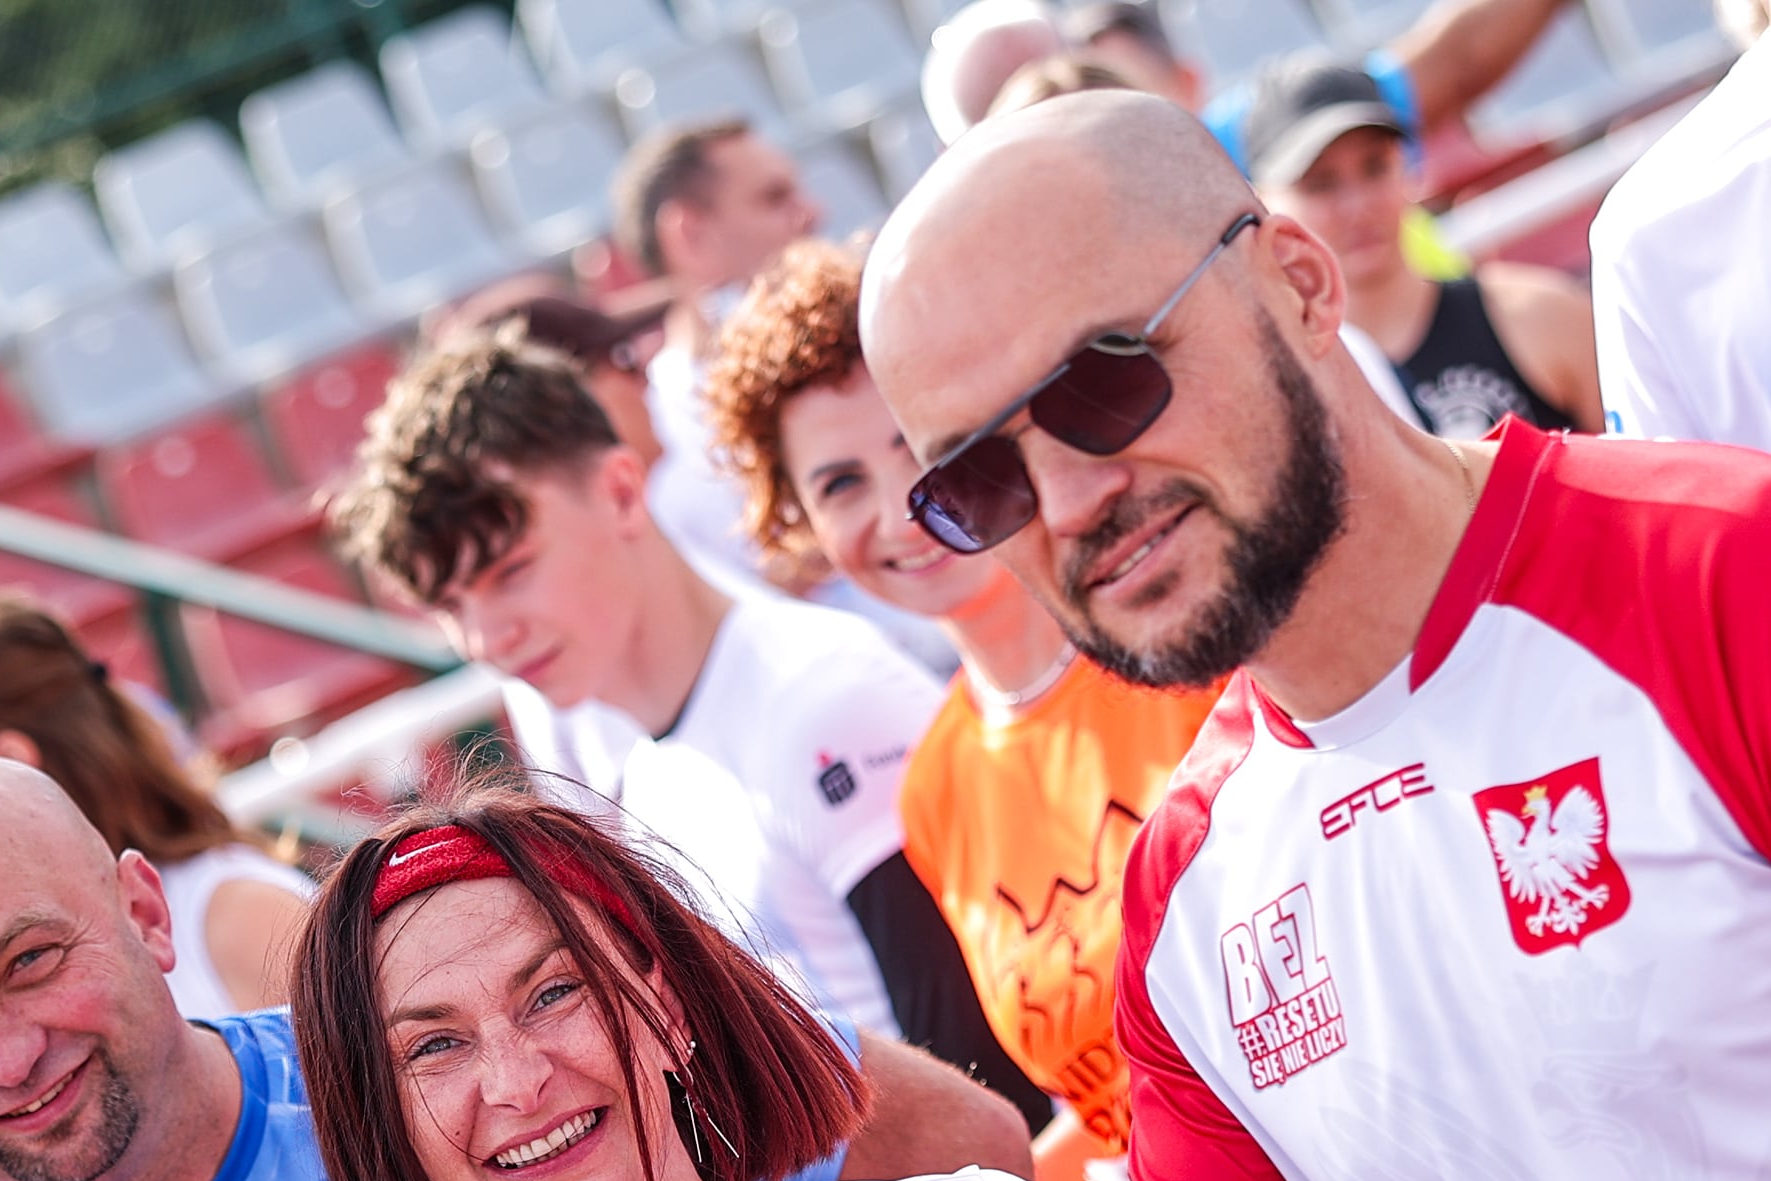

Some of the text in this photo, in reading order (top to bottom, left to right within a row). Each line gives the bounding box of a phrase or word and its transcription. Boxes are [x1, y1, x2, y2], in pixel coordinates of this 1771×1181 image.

[1220, 881, 1332, 1028] BEZ
[1238, 979, 1342, 1062] #RESETU
[1279, 1036, 1309, 1076] NIE
[1304, 1017, 1347, 1064] LICZY
